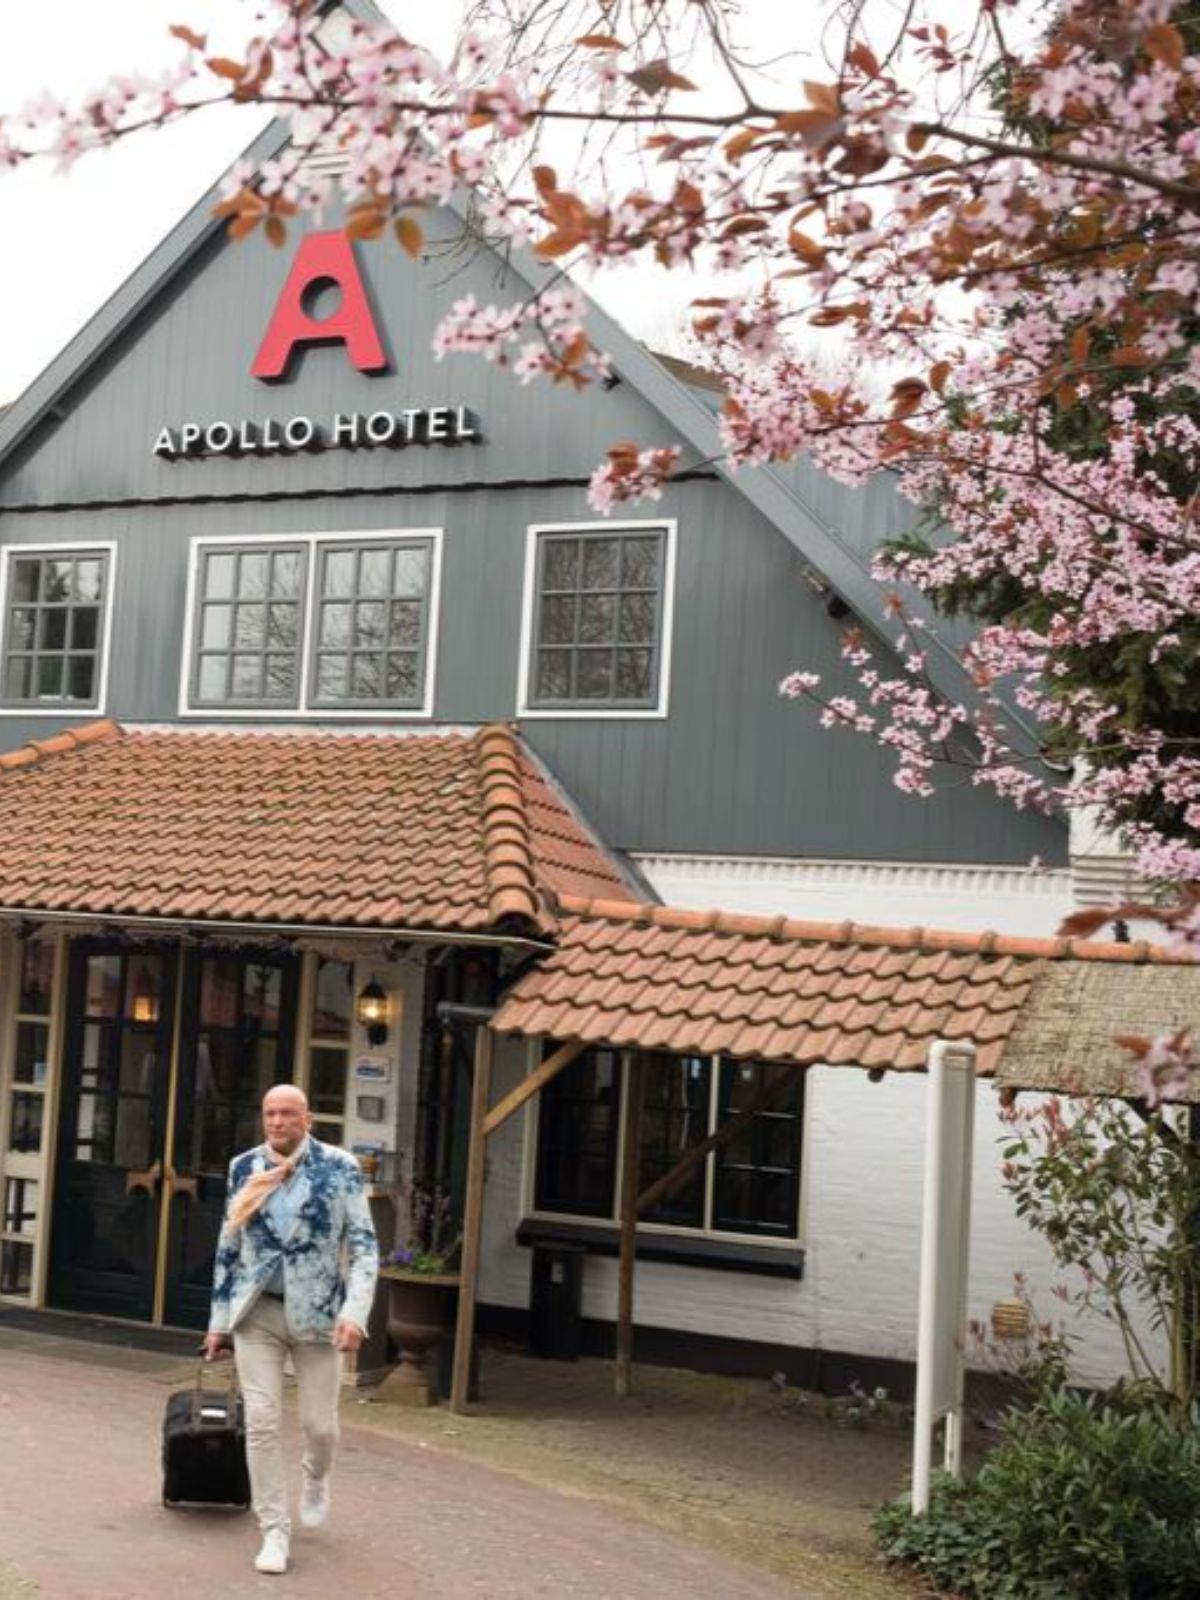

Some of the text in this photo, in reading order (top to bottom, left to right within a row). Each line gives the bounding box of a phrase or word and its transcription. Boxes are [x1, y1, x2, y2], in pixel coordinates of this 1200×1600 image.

[250, 230, 390, 382] A
[153, 405, 475, 453] APOLLO HOTEL
